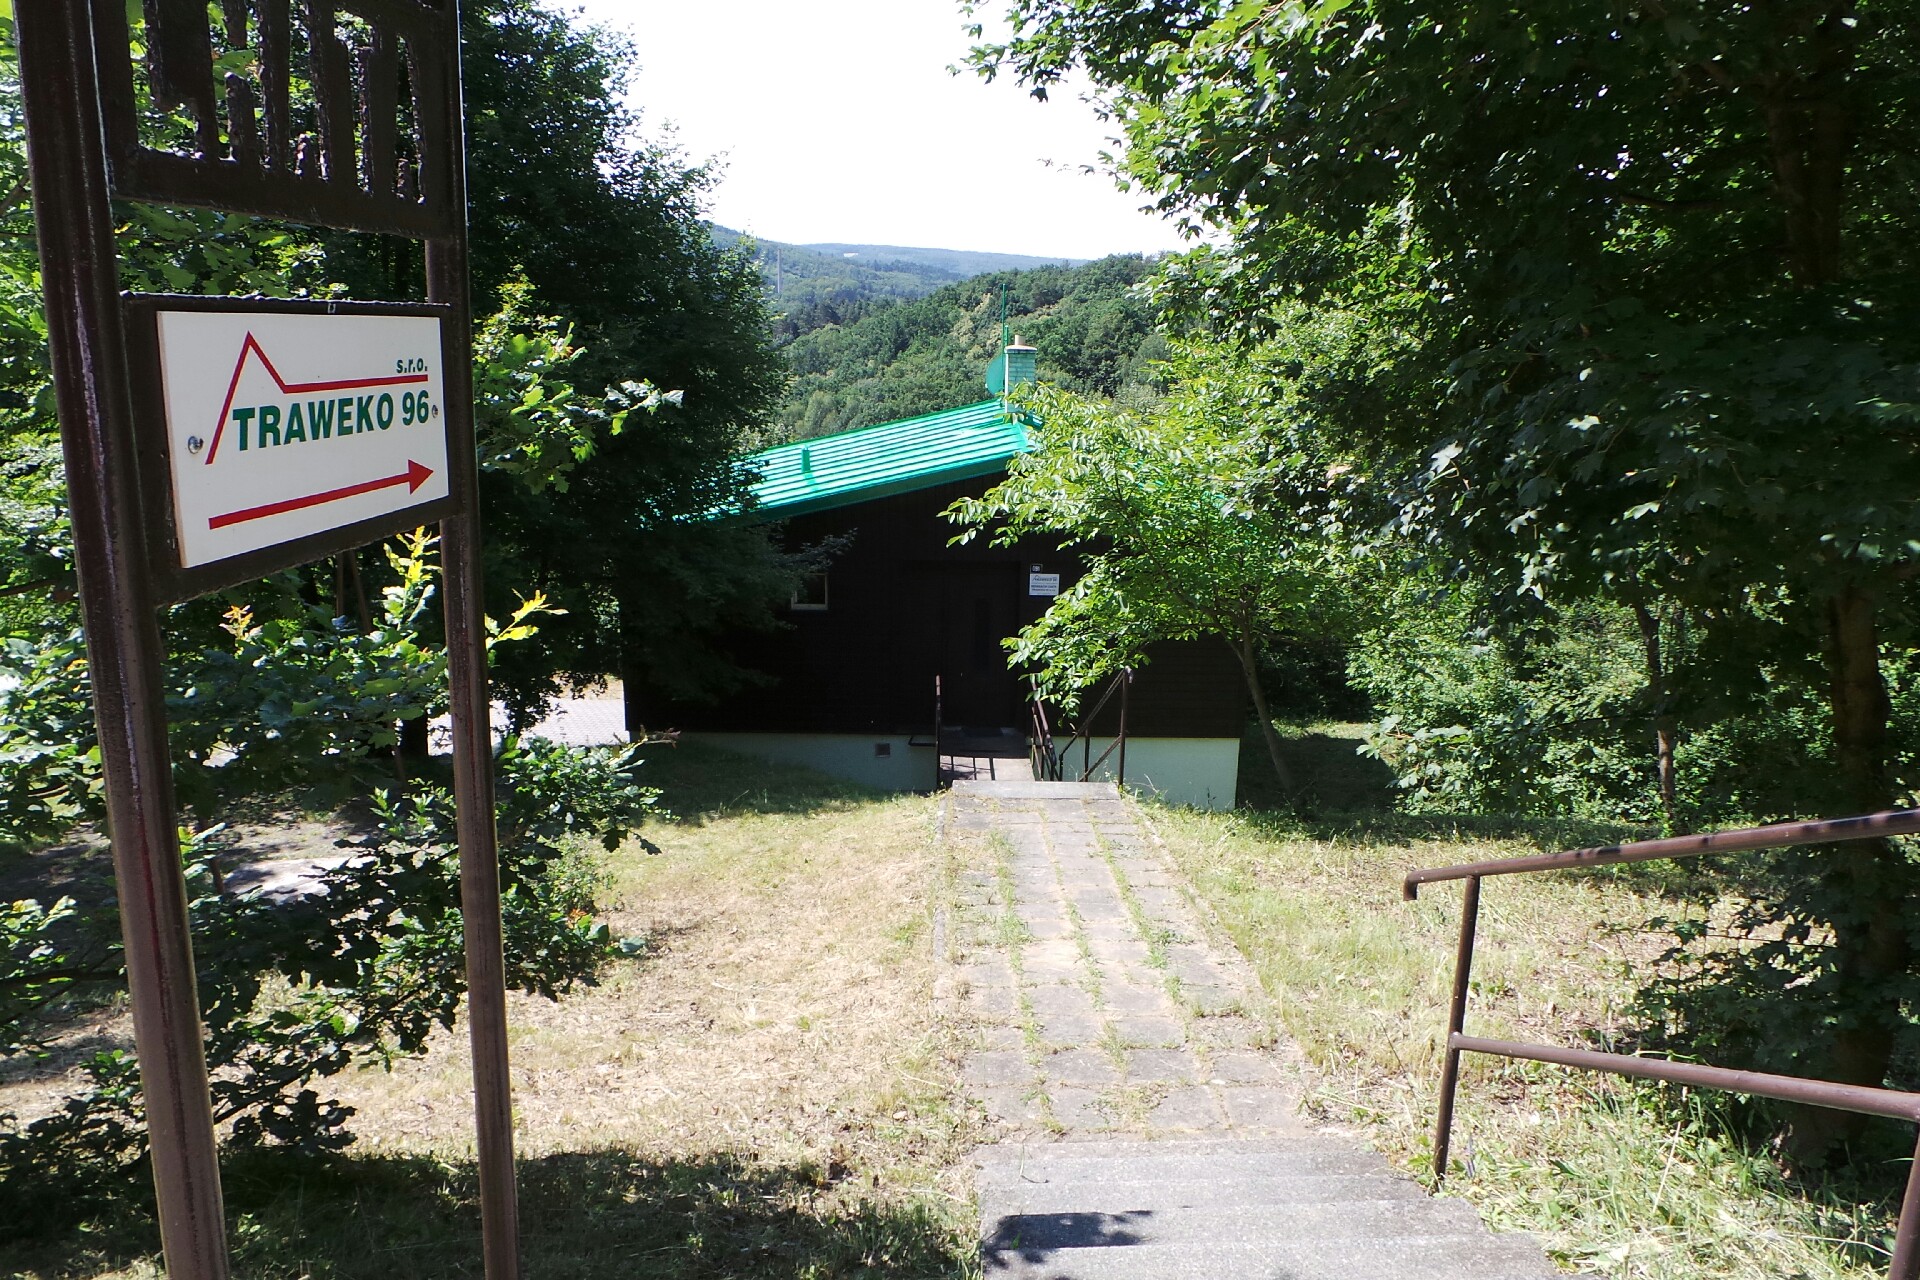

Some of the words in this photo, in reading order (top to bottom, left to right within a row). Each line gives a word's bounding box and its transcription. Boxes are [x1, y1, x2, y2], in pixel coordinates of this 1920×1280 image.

[396, 357, 428, 373] s.r.o.
[232, 392, 394, 451] TRAWEKO
[402, 390, 429, 426] 96
